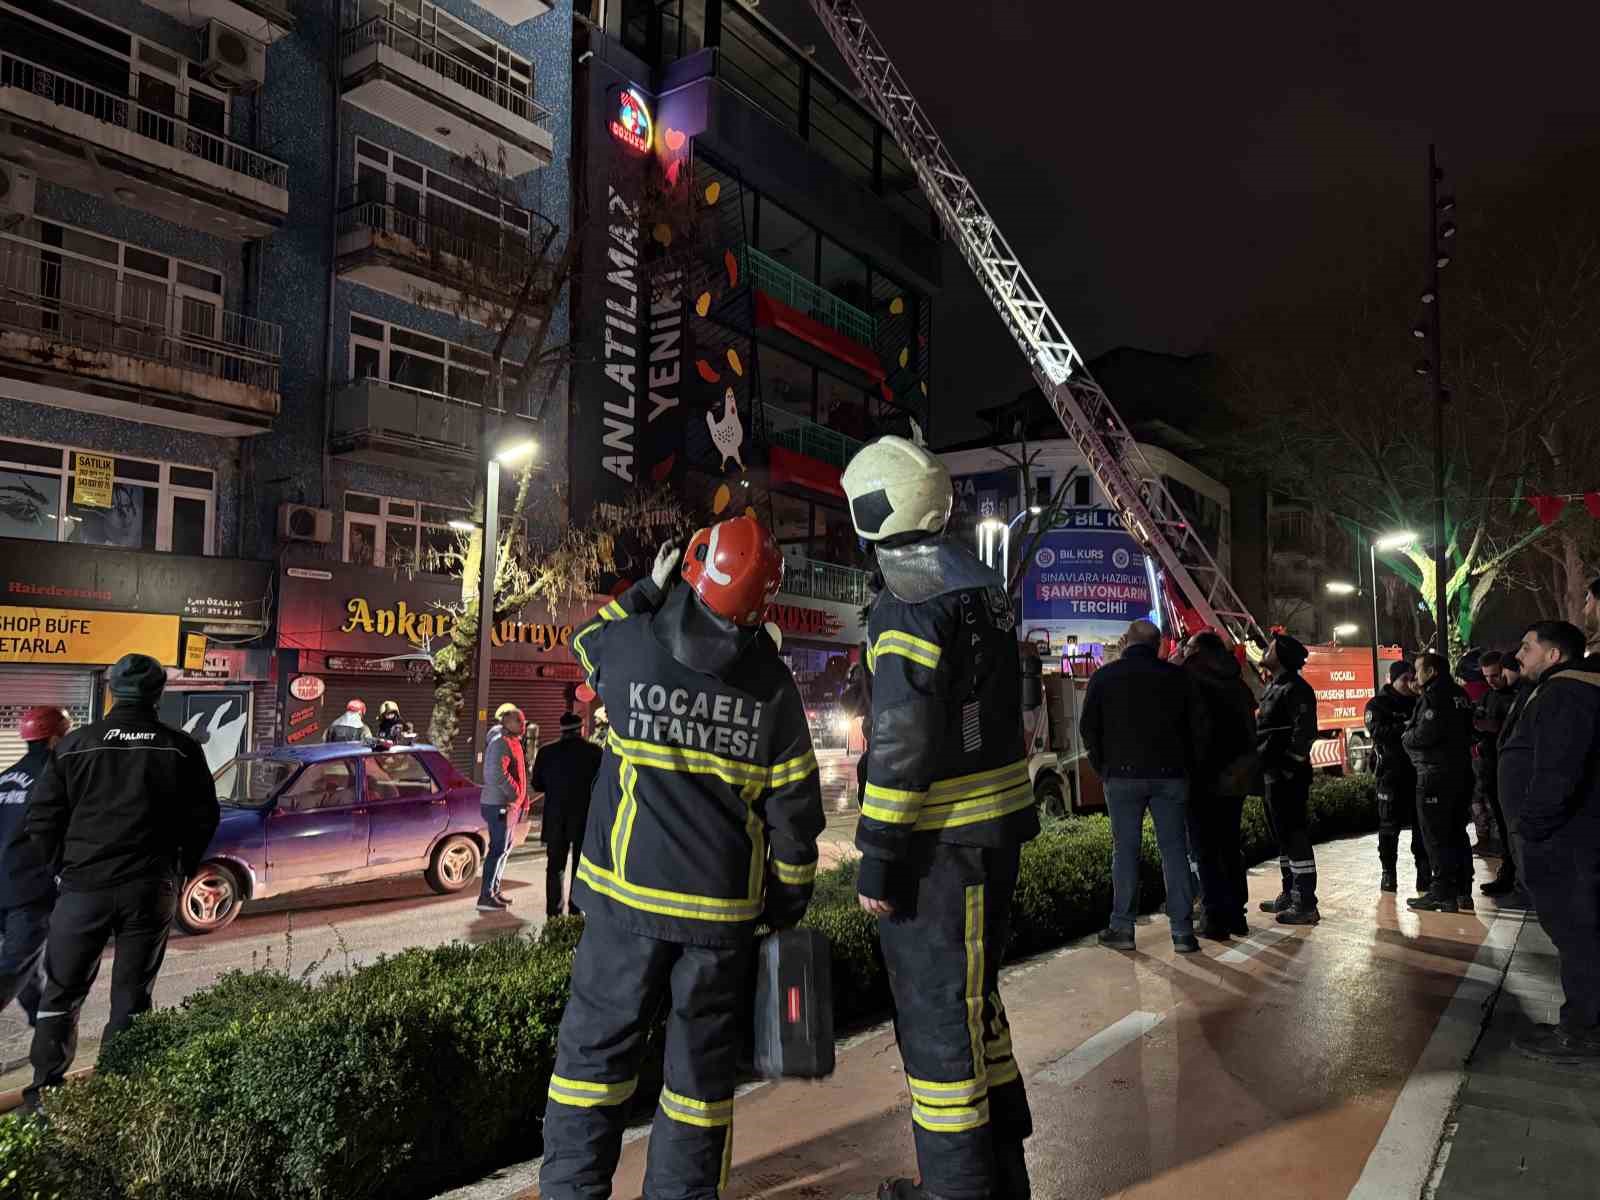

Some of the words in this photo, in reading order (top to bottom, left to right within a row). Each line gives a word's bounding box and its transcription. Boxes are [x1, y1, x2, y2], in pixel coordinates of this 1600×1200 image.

[1079, 550, 1104, 561] KURS
[1040, 573, 1100, 584] SINAVLARA
[1041, 584, 1147, 601] ŞAMPİYONLARIN
[1071, 600, 1127, 614] TERCİHİ!
[46, 615, 91, 635] BÜFE
[629, 682, 762, 728] KOCAELİ
[120, 732, 156, 742] PALMET
[628, 711, 761, 759] İTFAİYESİ
